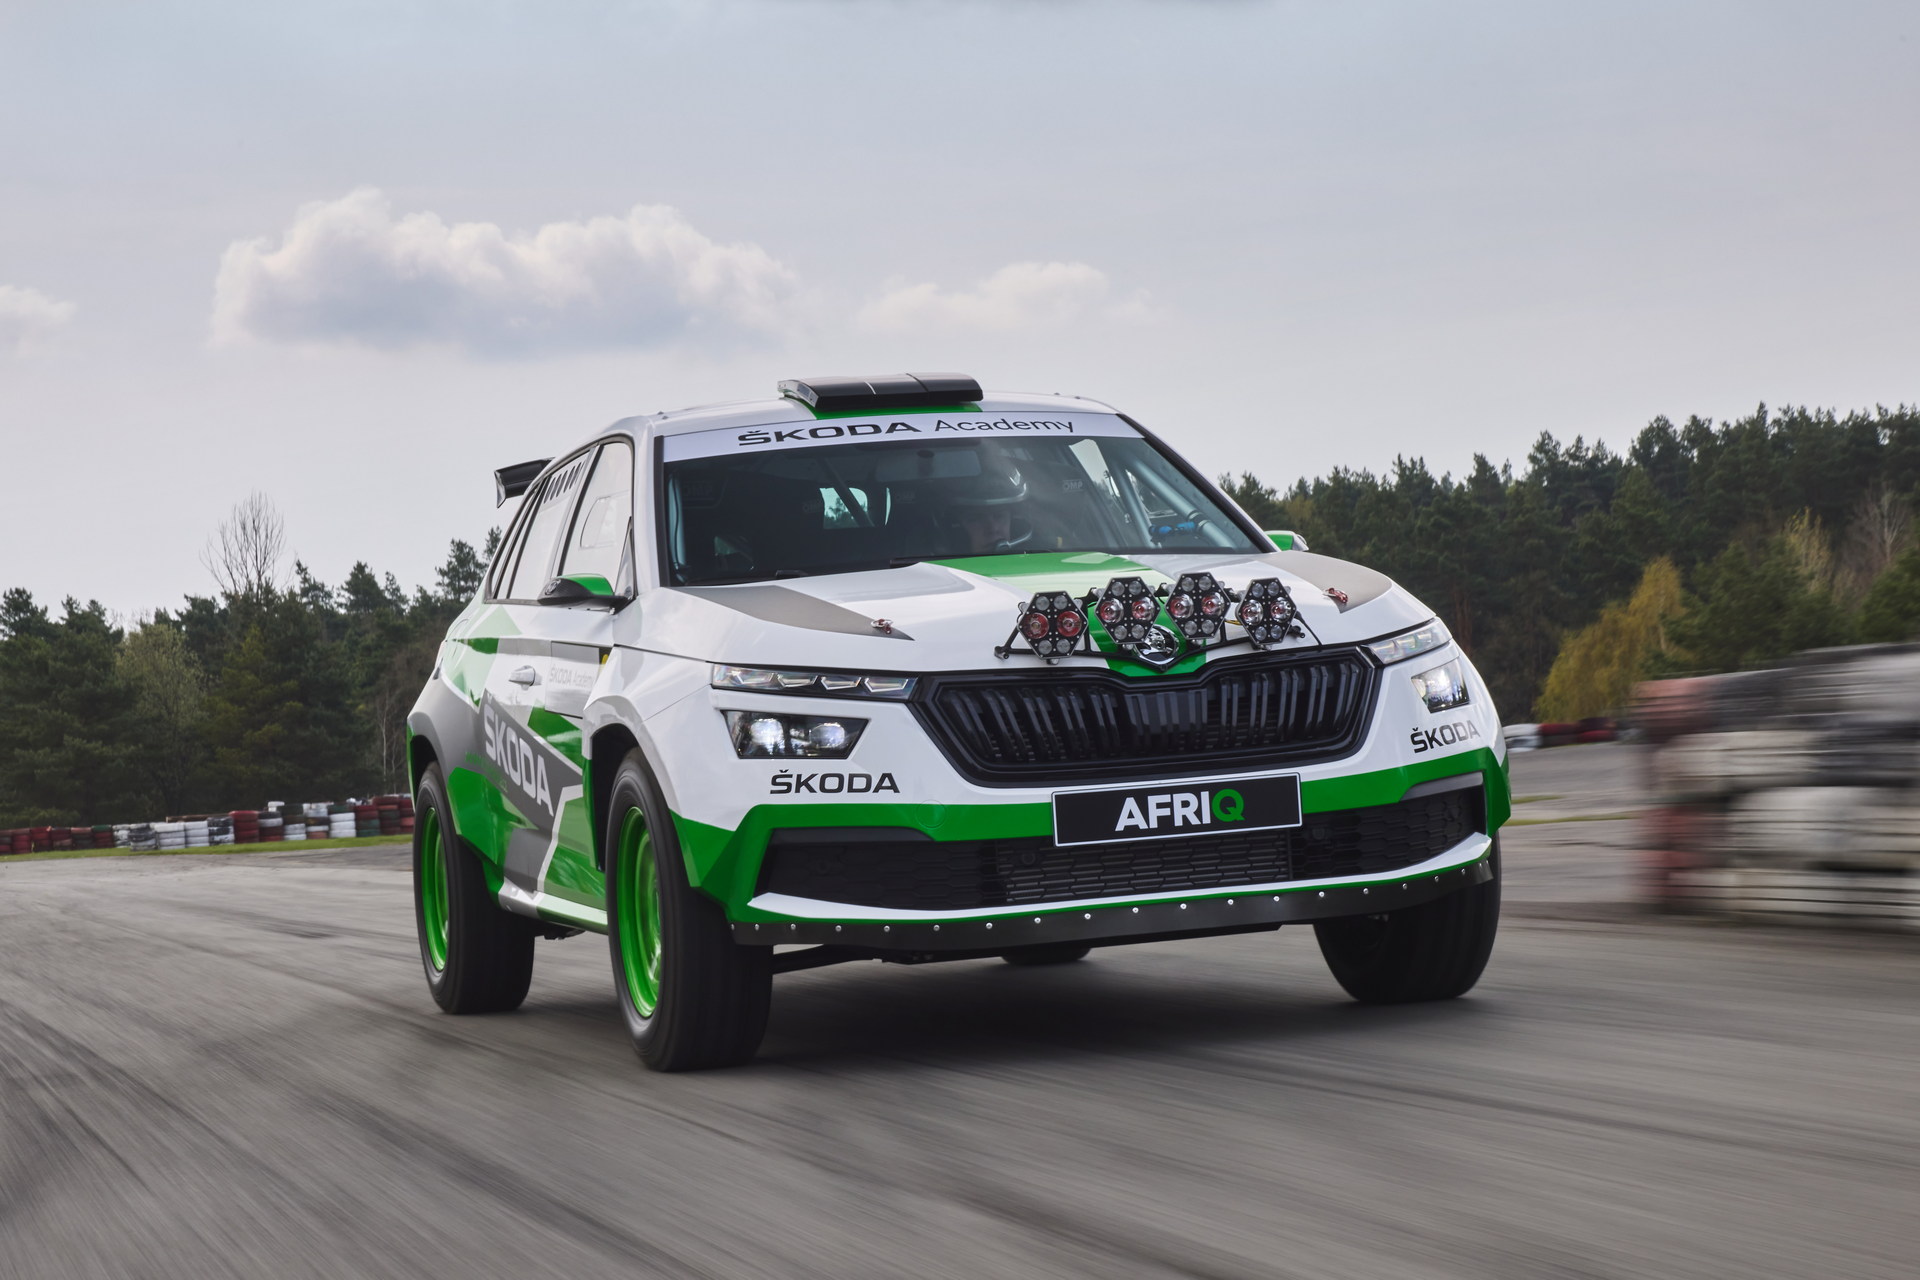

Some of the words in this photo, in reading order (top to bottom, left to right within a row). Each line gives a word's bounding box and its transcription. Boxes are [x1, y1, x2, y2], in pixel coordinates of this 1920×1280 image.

[737, 423, 922, 446] ŠKODA
[934, 418, 1074, 434] Academy
[1410, 720, 1481, 753] ŠKODA
[484, 693, 554, 817] ŠKODA
[770, 769, 900, 794] ŠKODA
[1115, 788, 1246, 832] AFRIQ
